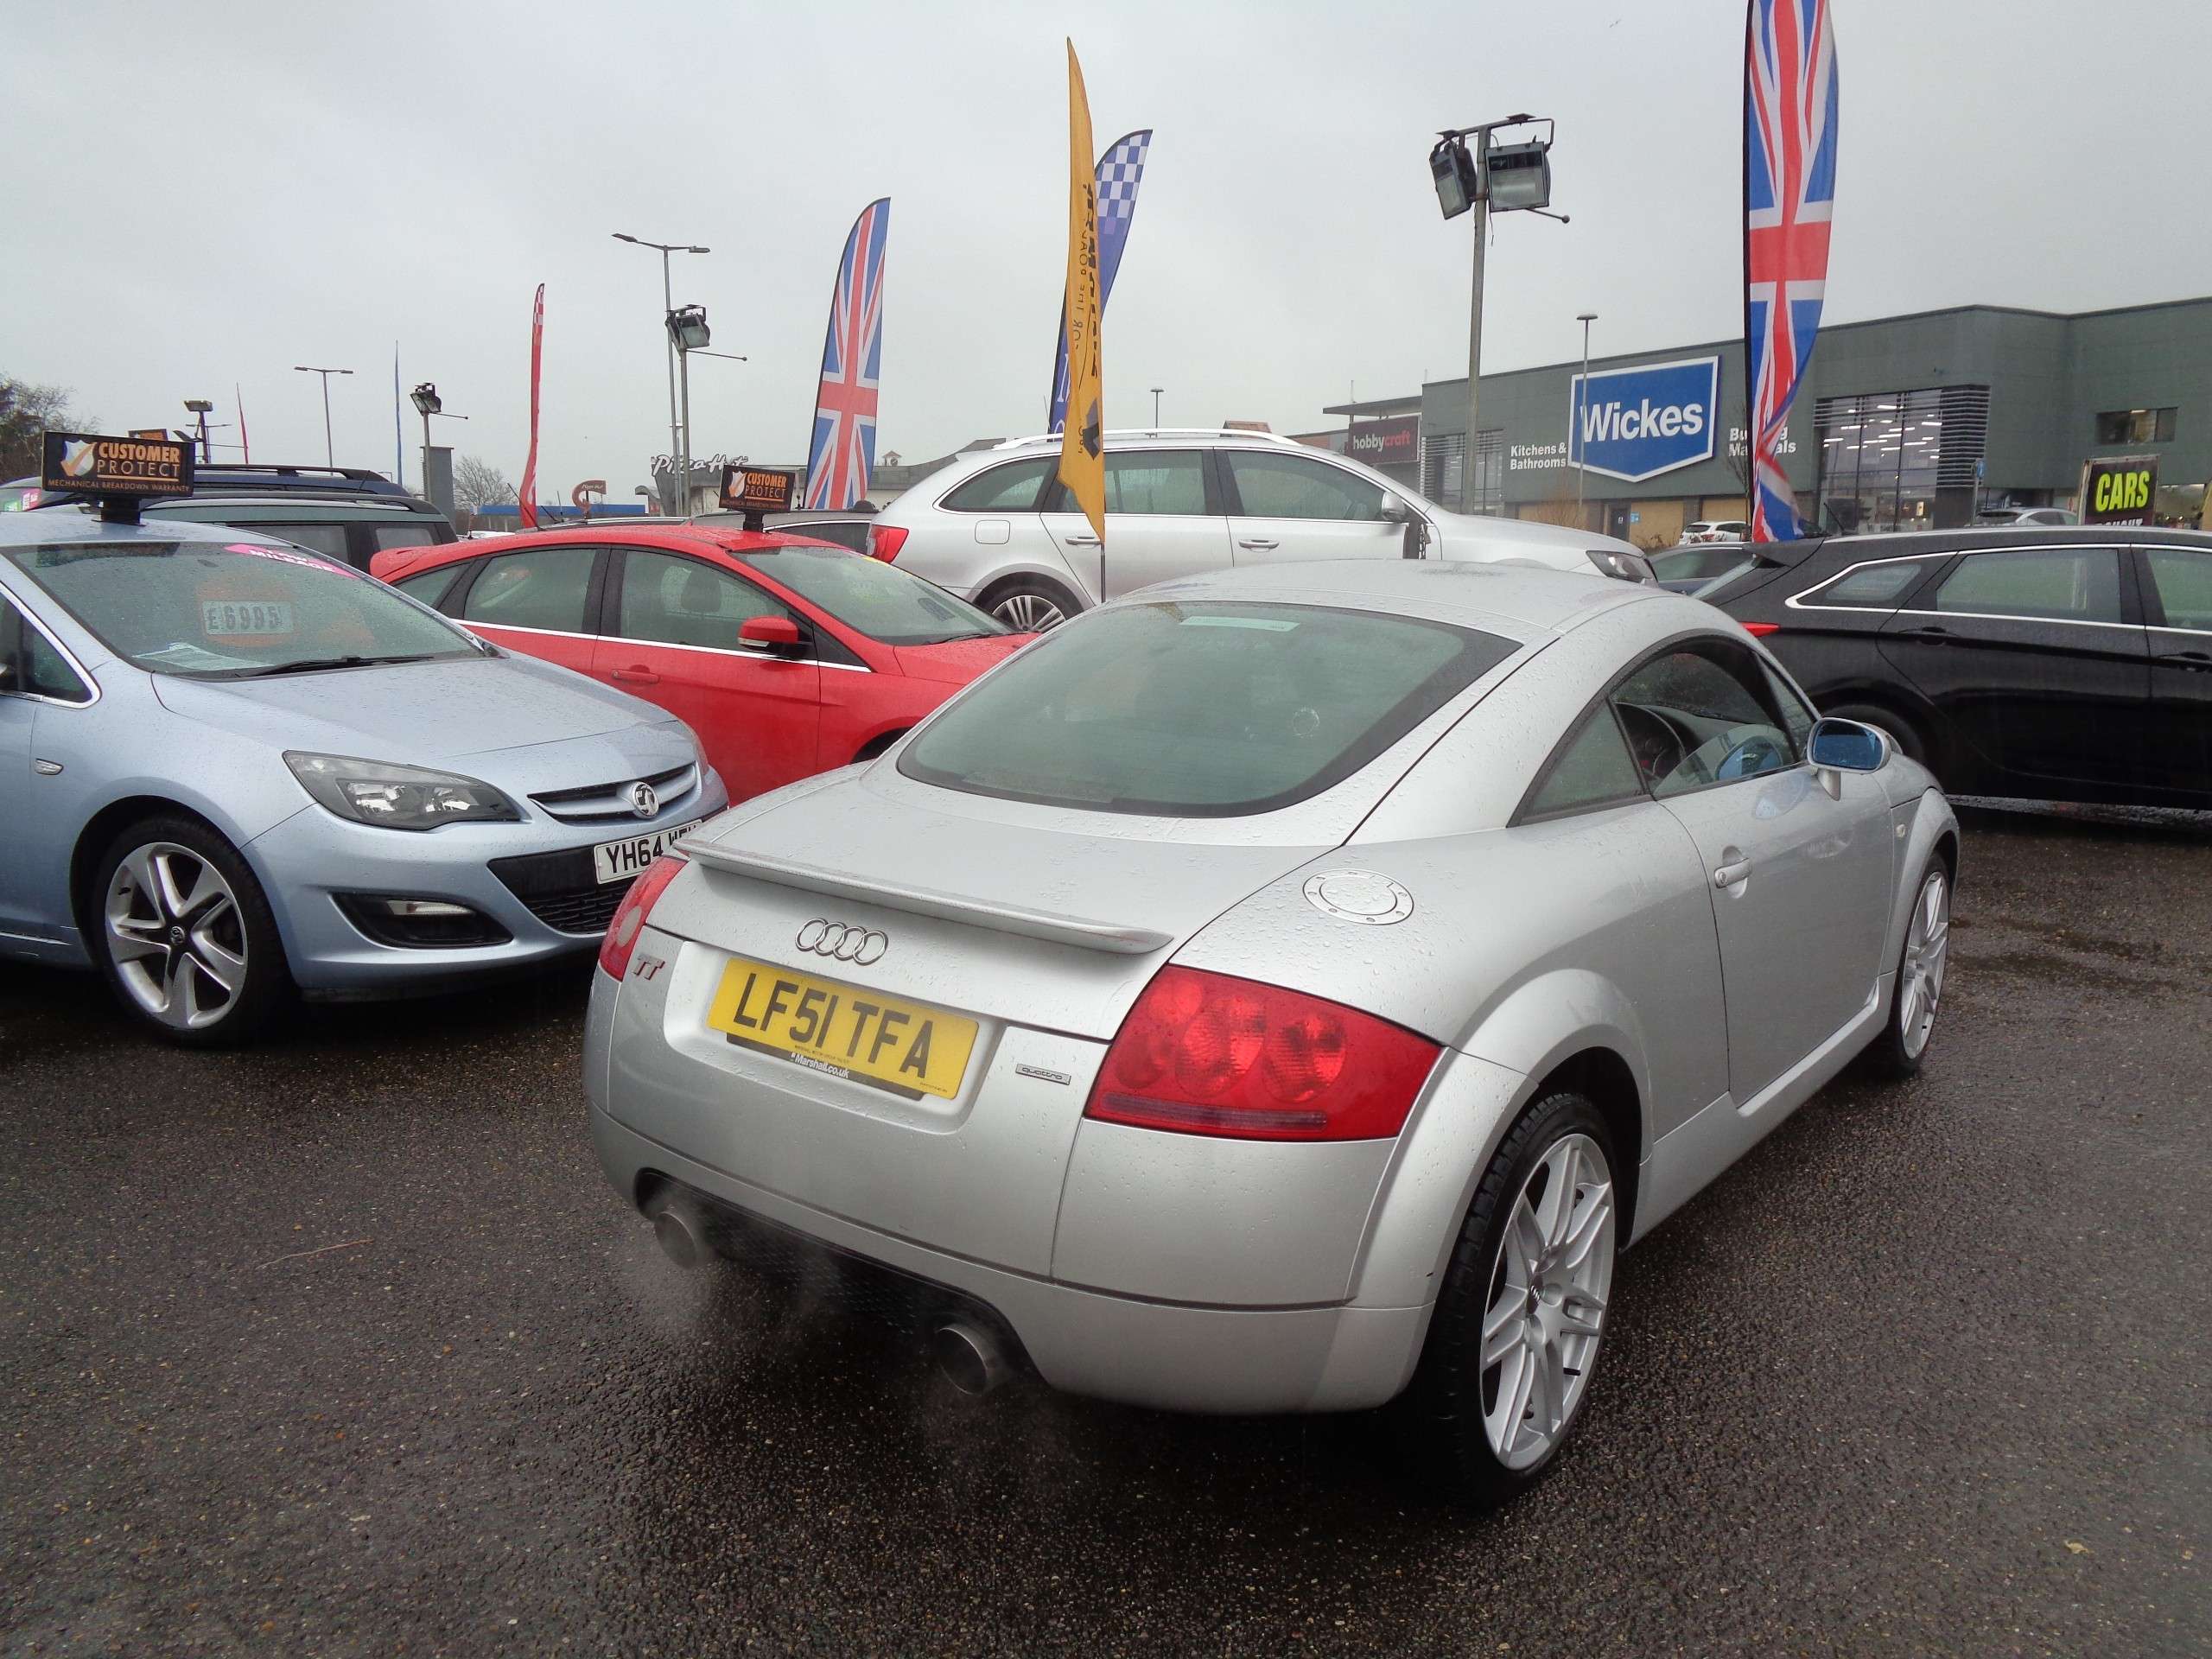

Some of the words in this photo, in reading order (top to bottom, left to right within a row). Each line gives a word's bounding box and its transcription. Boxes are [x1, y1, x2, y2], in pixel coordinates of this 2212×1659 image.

[1580, 398, 1703, 442] Wickes
[1353, 430, 1410, 452] hobbycraft
[1510, 444, 1556, 457] Kitchens
[1558, 442, 1567, 454] &
[1728, 438, 1797, 456] Maals
[99, 442, 181, 463] CUSTOMER
[97, 459, 181, 477] PROTECT
[651, 454, 706, 477] Pia
[708, 454, 748, 473] Ht
[1510, 457, 1567, 470] Bathrooms
[48, 478, 99, 489] MECHANICAL
[101, 481, 149, 491] BREAKDOWN
[151, 483, 190, 492] WARRANTY
[747, 472, 787, 488] CUSTOMER
[745, 484, 787, 499] PROTECT
[2095, 470, 2150, 512] CARS
[606, 835, 664, 874] YH64
[632, 954, 665, 981] TT
[734, 972, 839, 1049] LF51
[847, 1001, 933, 1078] TFA
[794, 1053, 850, 1079] Marshall.co.uk
[1021, 1067, 1063, 1080] quattro
